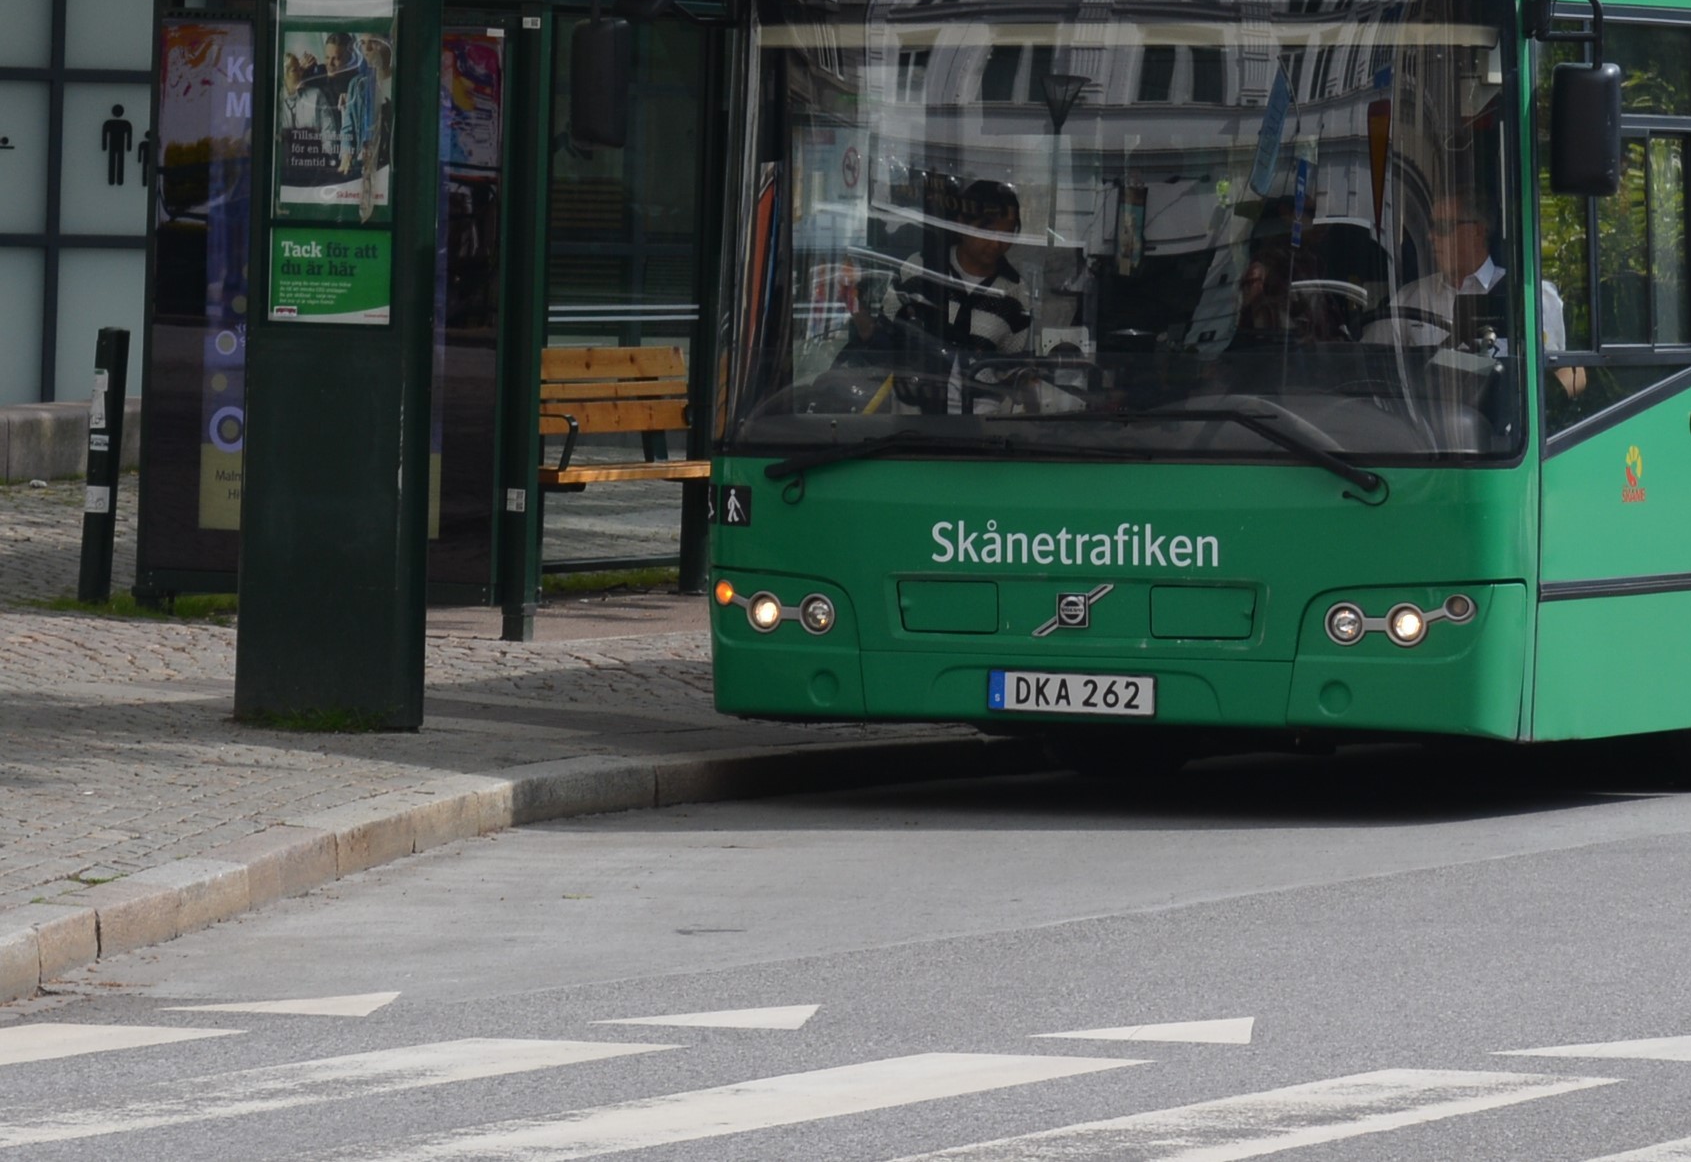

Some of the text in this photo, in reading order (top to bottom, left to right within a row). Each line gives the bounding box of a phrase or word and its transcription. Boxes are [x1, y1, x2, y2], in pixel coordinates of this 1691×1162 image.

[291, 143, 304, 154] för
[307, 145, 319, 154] en
[291, 157, 326, 167] framtid
[281, 240, 379, 259] Tack för att
[281, 259, 357, 277] du är här
[931, 519, 1219, 567] Skånetrafiken
[994, 693, 1001, 702] S
[1015, 676, 1141, 709] DKA 262
